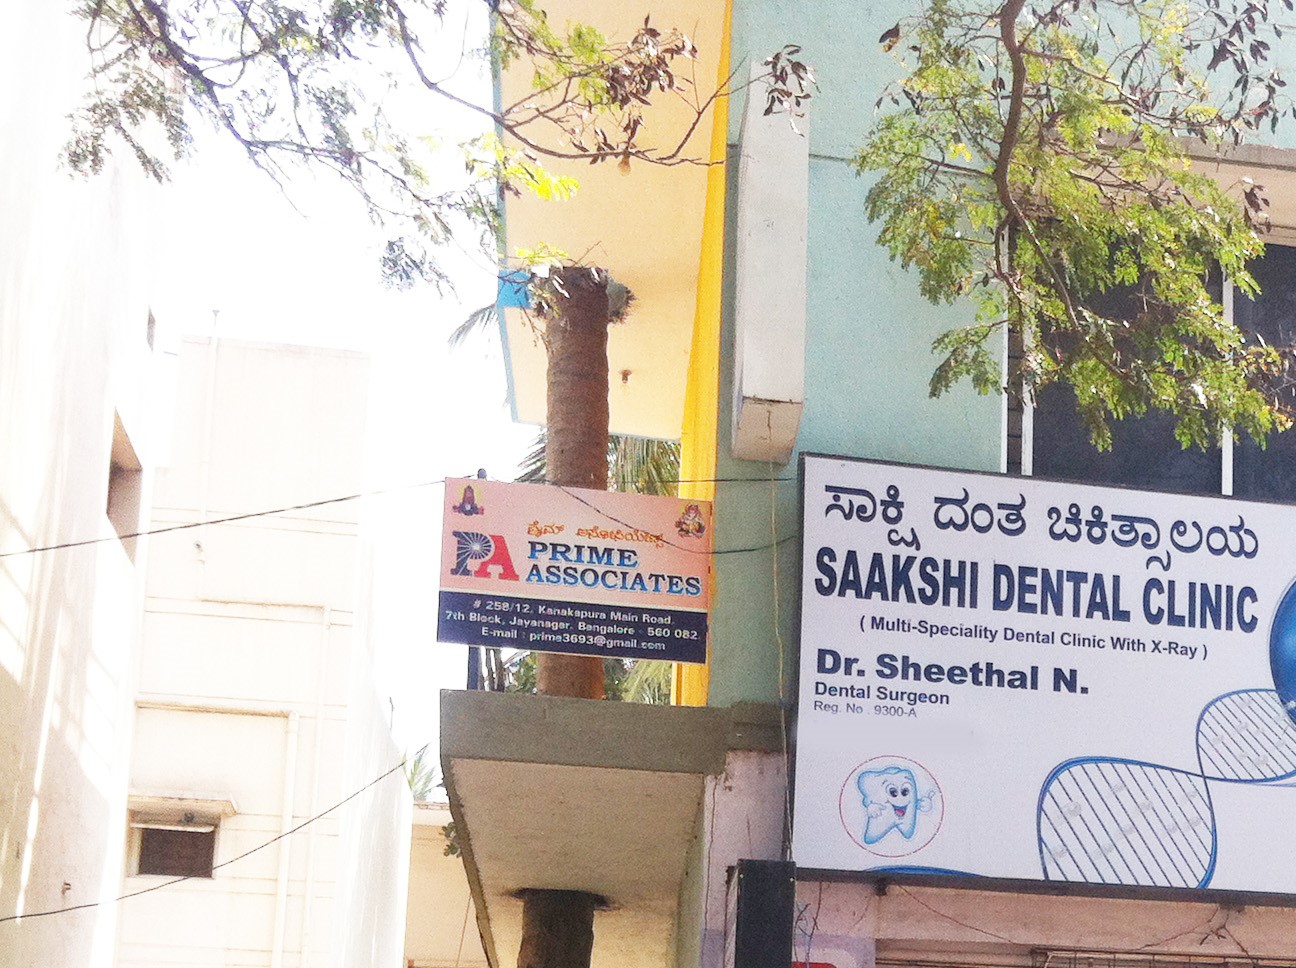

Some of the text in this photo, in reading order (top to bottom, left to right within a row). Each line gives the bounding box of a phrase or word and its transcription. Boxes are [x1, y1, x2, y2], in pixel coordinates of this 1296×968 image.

[825, 485, 1259, 572] ಸಾಕ್ಷಿ ದಂತ ಚಿಕಿತ್ಸಾಲಯ
[528, 541, 639, 568] PRIME
[526, 564, 702, 596] ASSOCIATES
[814, 546, 1260, 634] SAAKSHI DENTAL CLINIC
[445, 610, 464, 621] 7th
[578, 621, 635, 636] Bangalore
[647, 627, 670, 638] 560
[538, 605, 606, 620] Kanakapura
[610, 610, 638, 622] Main
[482, 626, 517, 639] E-mail
[529, 631, 666, 650] prime3693@gmail.com
[871, 615, 998, 642] Multi-Speciality
[1003, 627, 1055, 646] Dental
[1060, 631, 1106, 650] Clinic
[1110, 635, 1147, 653] With
[1151, 639, 1198, 659] X-Ray
[816, 647, 1089, 694] Dr. Sheethal N.
[815, 681, 950, 706] Dental Surgeon
[874, 705, 917, 718] 9300-A
